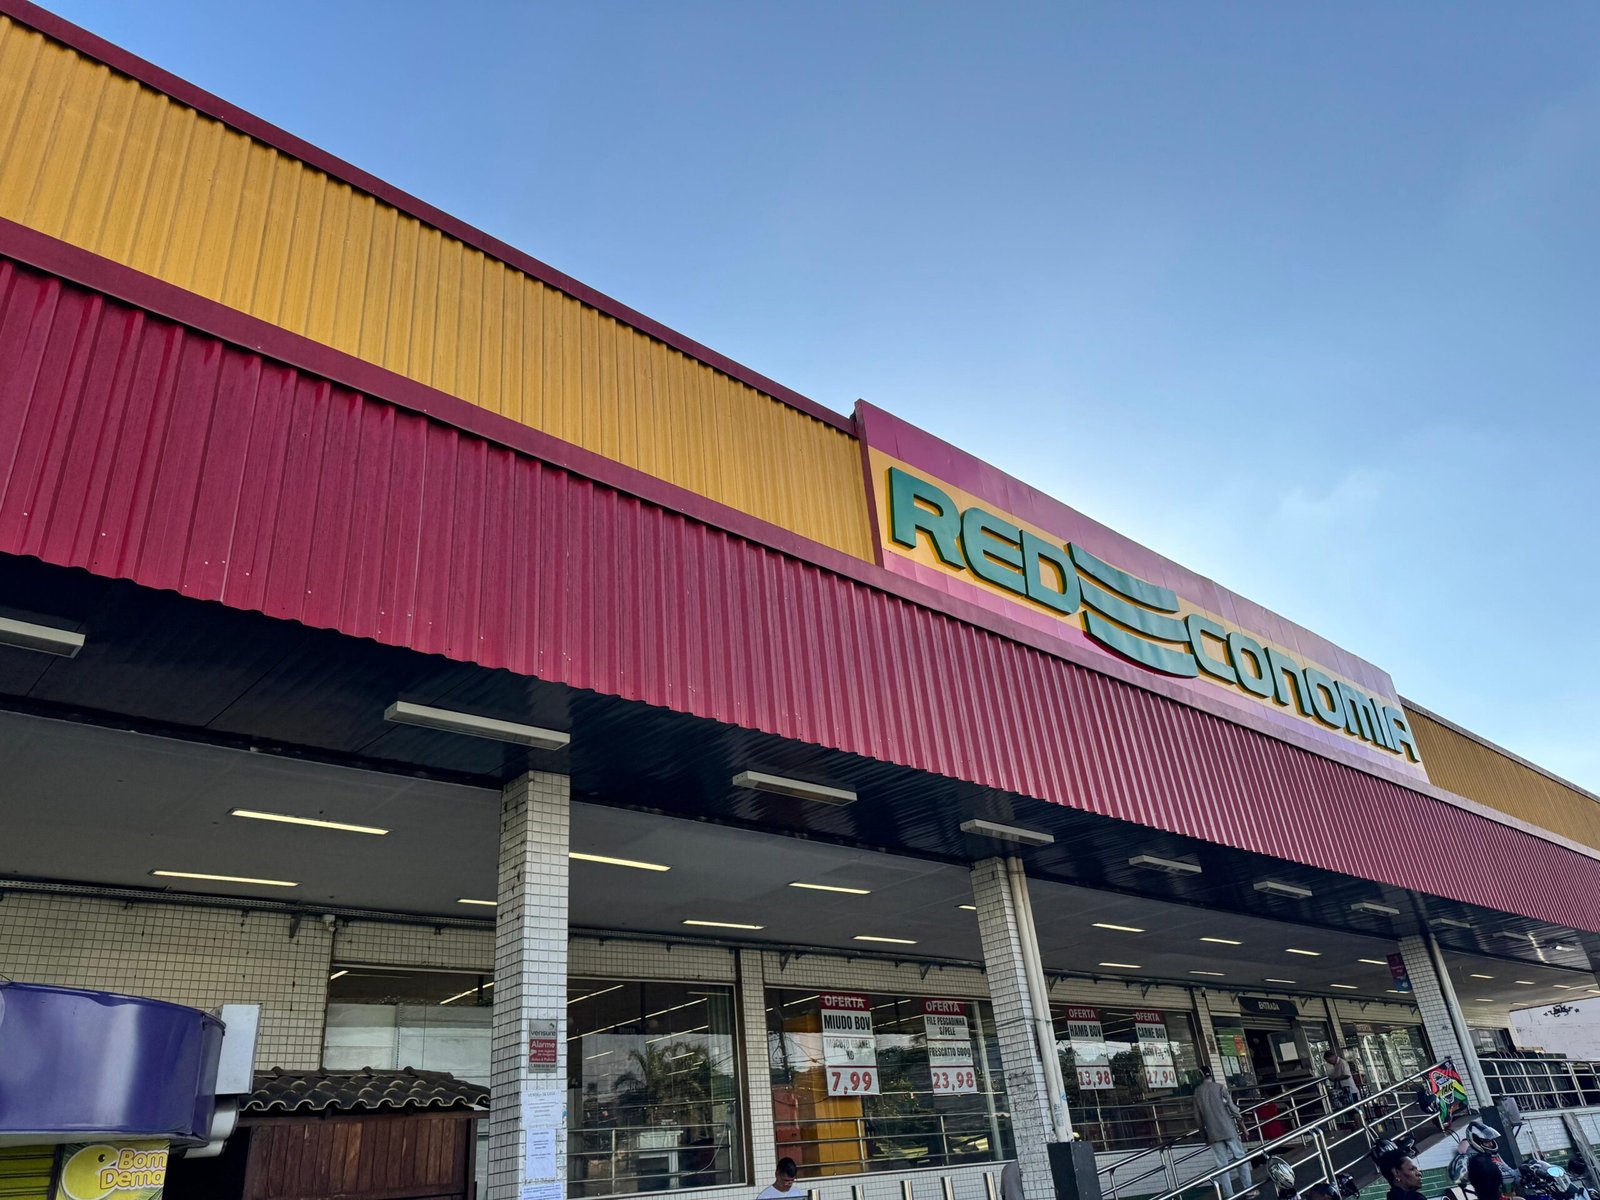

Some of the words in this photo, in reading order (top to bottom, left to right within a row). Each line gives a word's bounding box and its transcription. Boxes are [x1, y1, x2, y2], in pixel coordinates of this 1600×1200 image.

[824, 995, 865, 1008] OFERTA
[925, 1001, 960, 1012] OFERTA
[1068, 1008, 1096, 1019] OFERTA
[1136, 1012, 1160, 1021] OFERTA
[823, 1015, 853, 1030] MIUDO
[854, 1015, 871, 1030] BOV
[531, 1040, 555, 1049] Alarme
[832, 1071, 872, 1094] 7,99
[933, 1071, 974, 1092] 23,98
[118, 1148, 167, 1169] Bom
